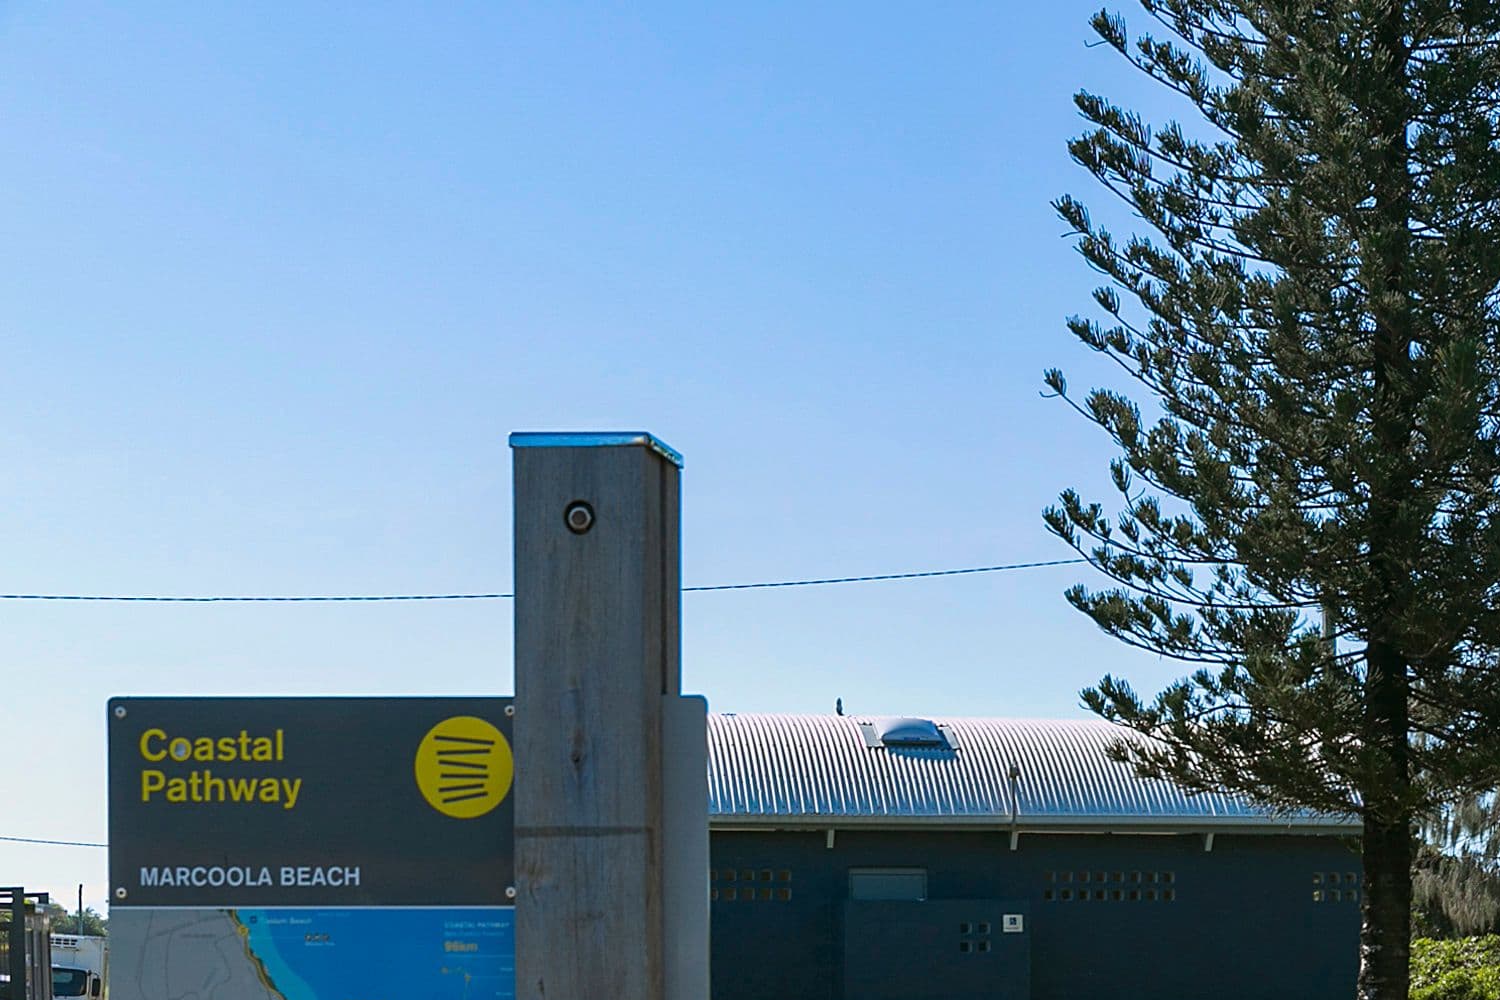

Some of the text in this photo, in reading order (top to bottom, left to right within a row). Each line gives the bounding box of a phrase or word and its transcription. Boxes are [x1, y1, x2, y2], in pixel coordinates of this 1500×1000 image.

[139, 728, 284, 762] Coastal
[141, 769, 302, 809] Pathway
[140, 867, 360, 886] MARCOOLA BEACH
